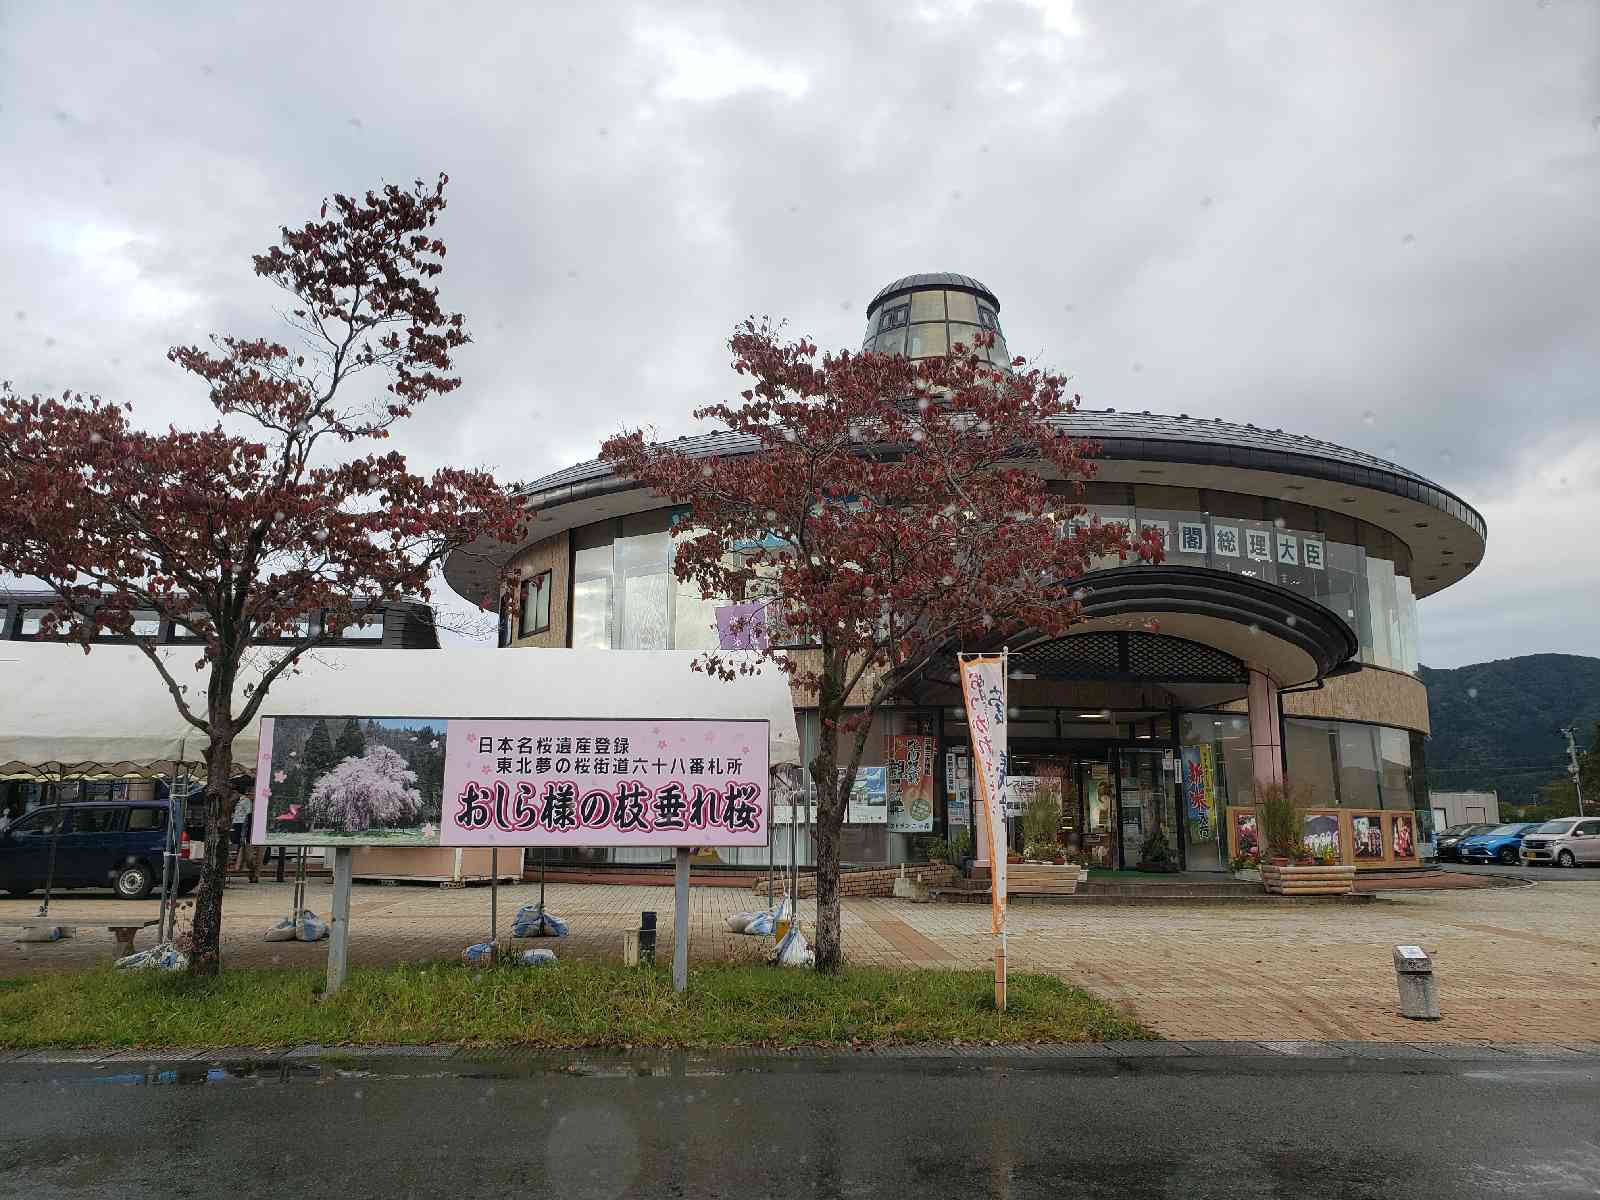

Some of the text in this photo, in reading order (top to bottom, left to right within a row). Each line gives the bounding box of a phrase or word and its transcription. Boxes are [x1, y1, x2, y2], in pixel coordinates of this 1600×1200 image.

[478, 736, 631, 754] 日本名桜遺産登録
[495, 757, 744, 775] 東北夢の桜街道六十八番札所
[456, 782, 760, 831] おしら様の枝垂れ桜
